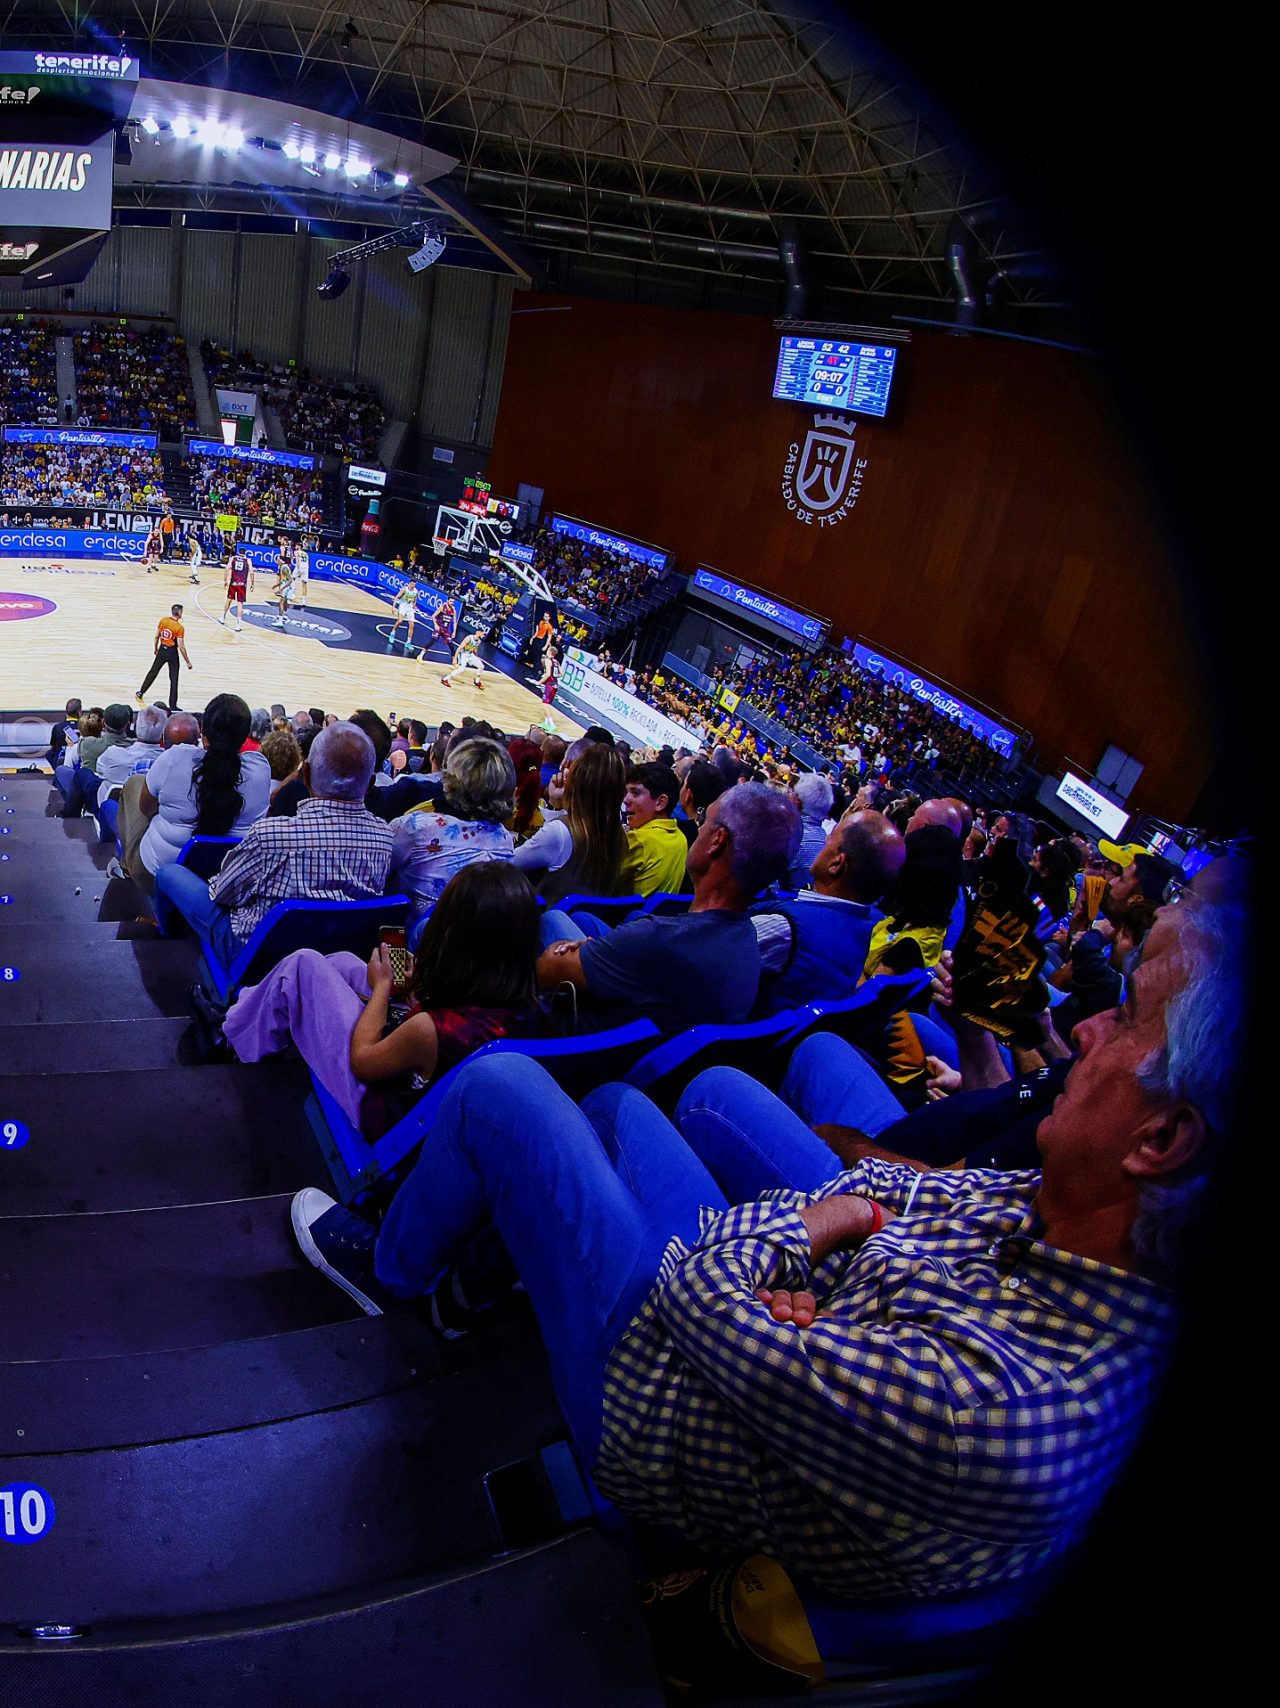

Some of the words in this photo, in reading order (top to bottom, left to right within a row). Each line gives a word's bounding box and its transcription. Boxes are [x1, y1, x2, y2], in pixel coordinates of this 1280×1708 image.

[34, 53, 132, 77] tenerife!
[35, 67, 78, 75] despierta
[81, 69, 120, 77] emociones
[814, 370, 843, 383] 09:07
[782, 442, 800, 511] CABILDO
[796, 508, 814, 525] DE
[817, 458, 868, 528] TENERIFE
[0, 532, 66, 547] endesa
[83, 534, 146, 551] endesa
[502, 546, 533, 560] endesa
[315, 559, 369, 577] endesa
[734, 588, 780, 619] Pantástico
[562, 660, 586, 693] BB
[612, 696, 630, 716] 100%
[630, 707, 658, 734] RECICLADA
[911, 678, 964, 719] Pantástico
[4, 967, 14, 980] 8
[3, 1123, 18, 1145] 9
[0, 1490, 46, 1536] 10
